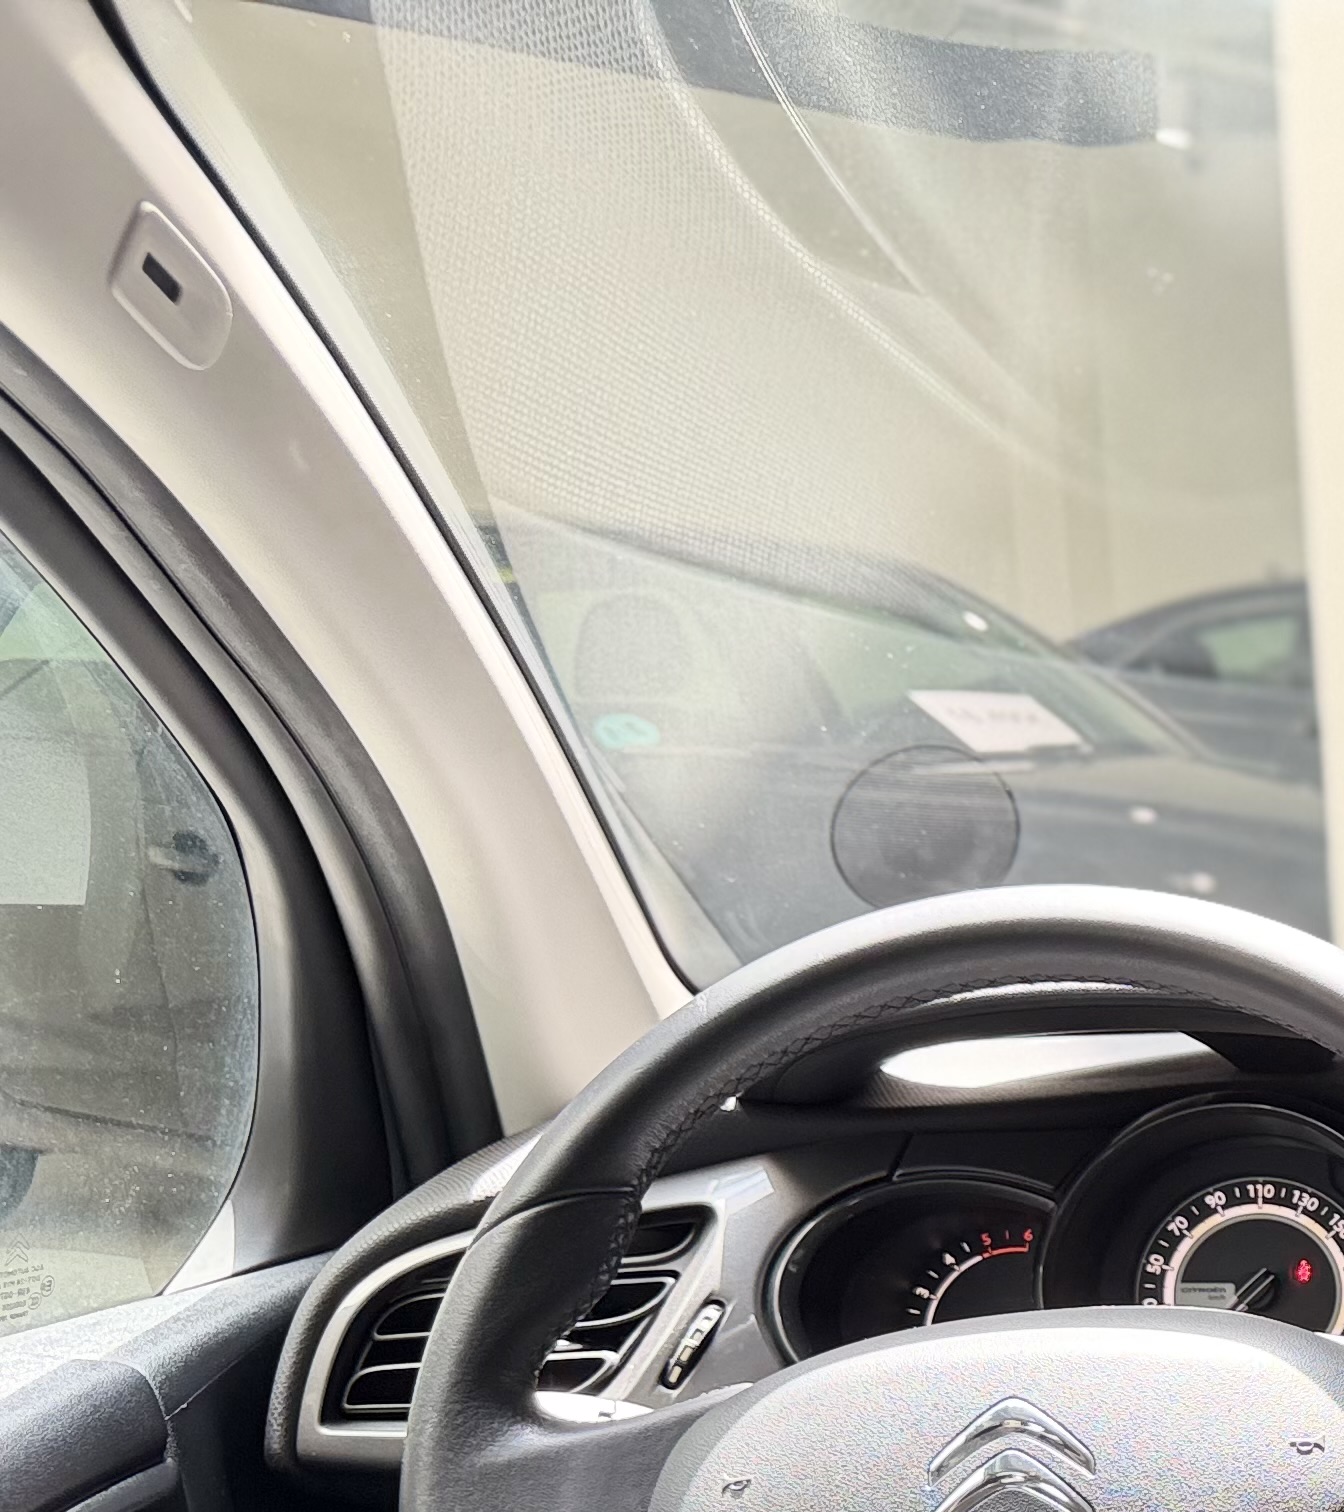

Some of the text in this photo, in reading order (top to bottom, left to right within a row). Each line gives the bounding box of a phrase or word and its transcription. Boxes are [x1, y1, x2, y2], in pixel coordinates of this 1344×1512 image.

[1204, 1190, 1227, 1209] 90
[1246, 1183, 1275, 1199] 110
[1292, 1189, 1319, 1212] 130
[1023, 1228, 1034, 1242] 6
[1166, 1215, 1189, 1236] 70
[980, 1232, 992, 1246] 5
[1145, 1253, 1166, 1275] 50
